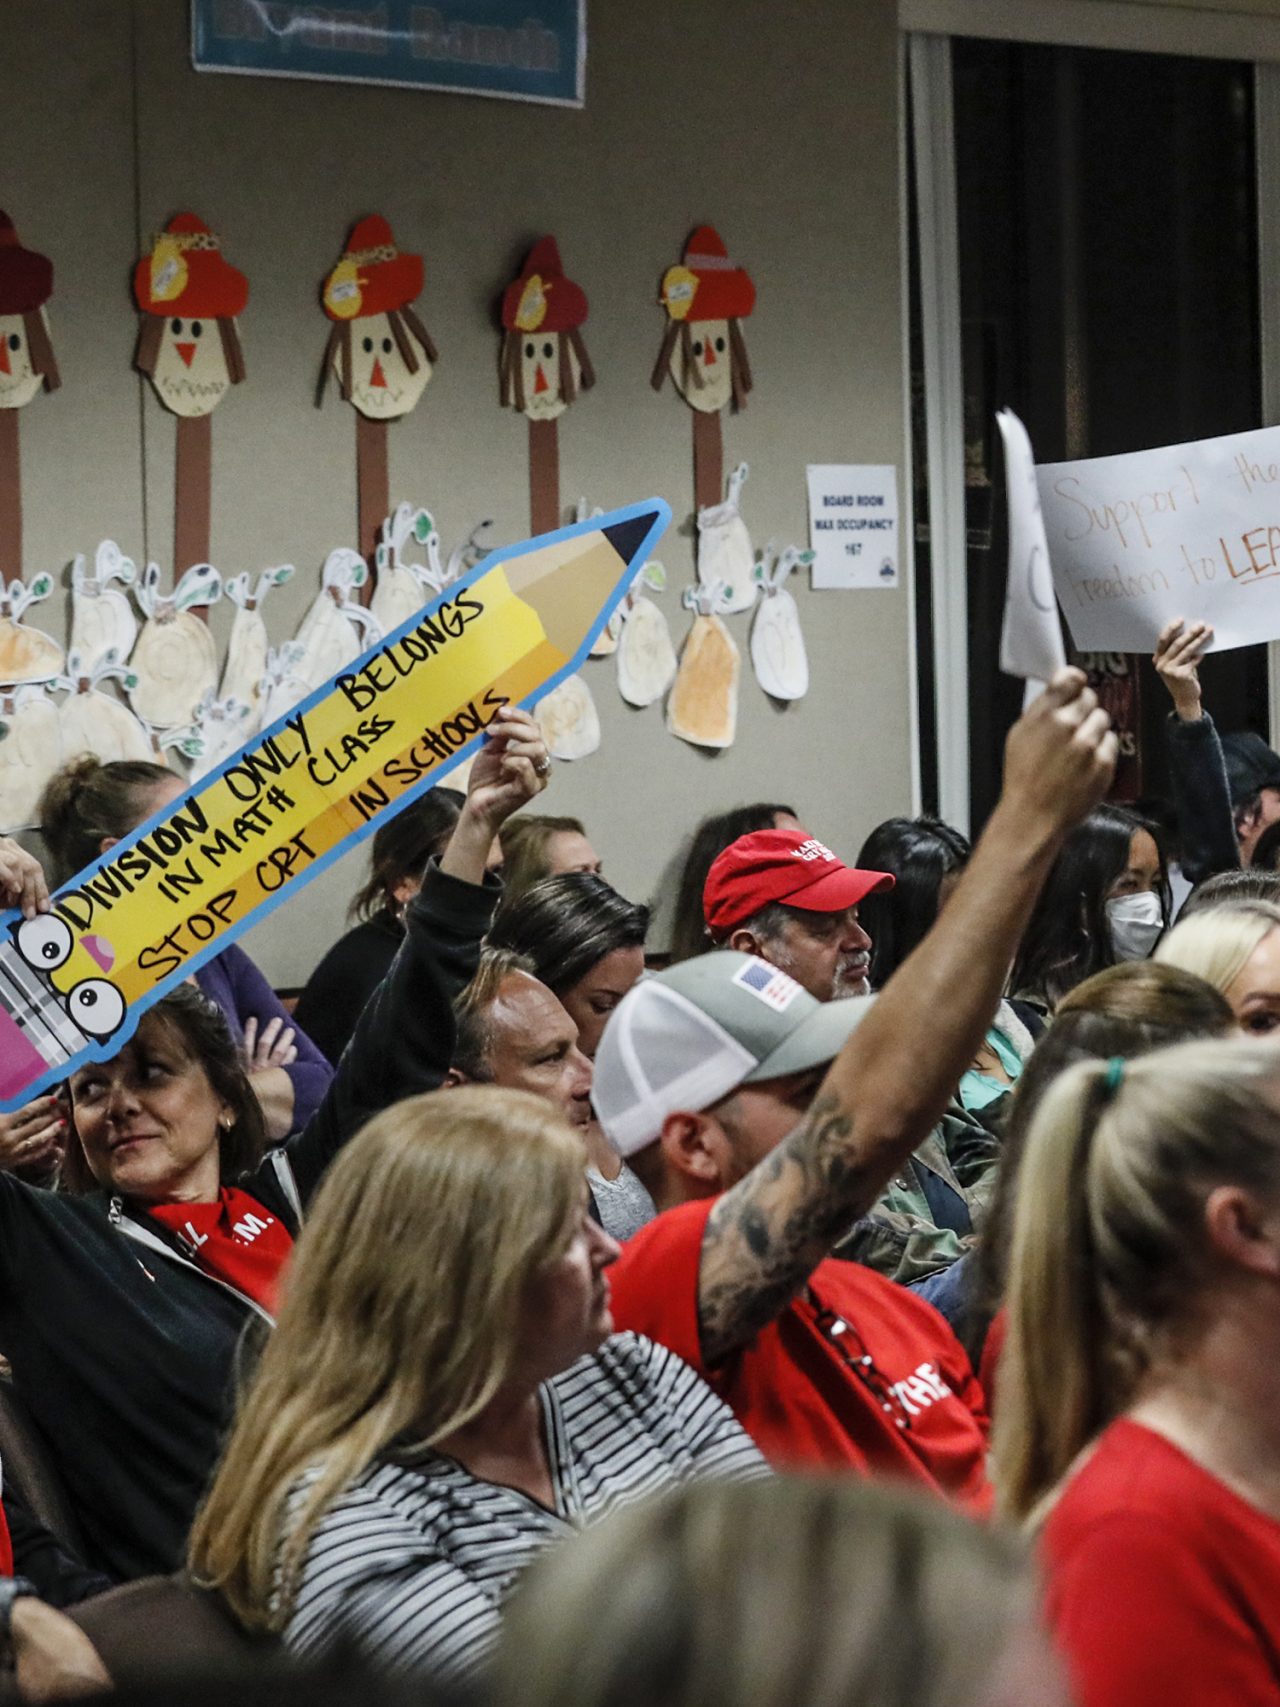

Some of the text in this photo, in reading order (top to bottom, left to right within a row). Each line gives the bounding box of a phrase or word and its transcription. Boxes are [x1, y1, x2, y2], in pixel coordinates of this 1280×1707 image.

[837, 519, 894, 531] OCCUPANCY
[1055, 453, 1280, 549] Support the
[1181, 544, 1216, 585] to
[55, 588, 484, 931] DIVISION ONLY BELONGS
[158, 713, 396, 904] IN MATH CLASS
[138, 689, 511, 981] STOP CRT IN SCHOOLS
